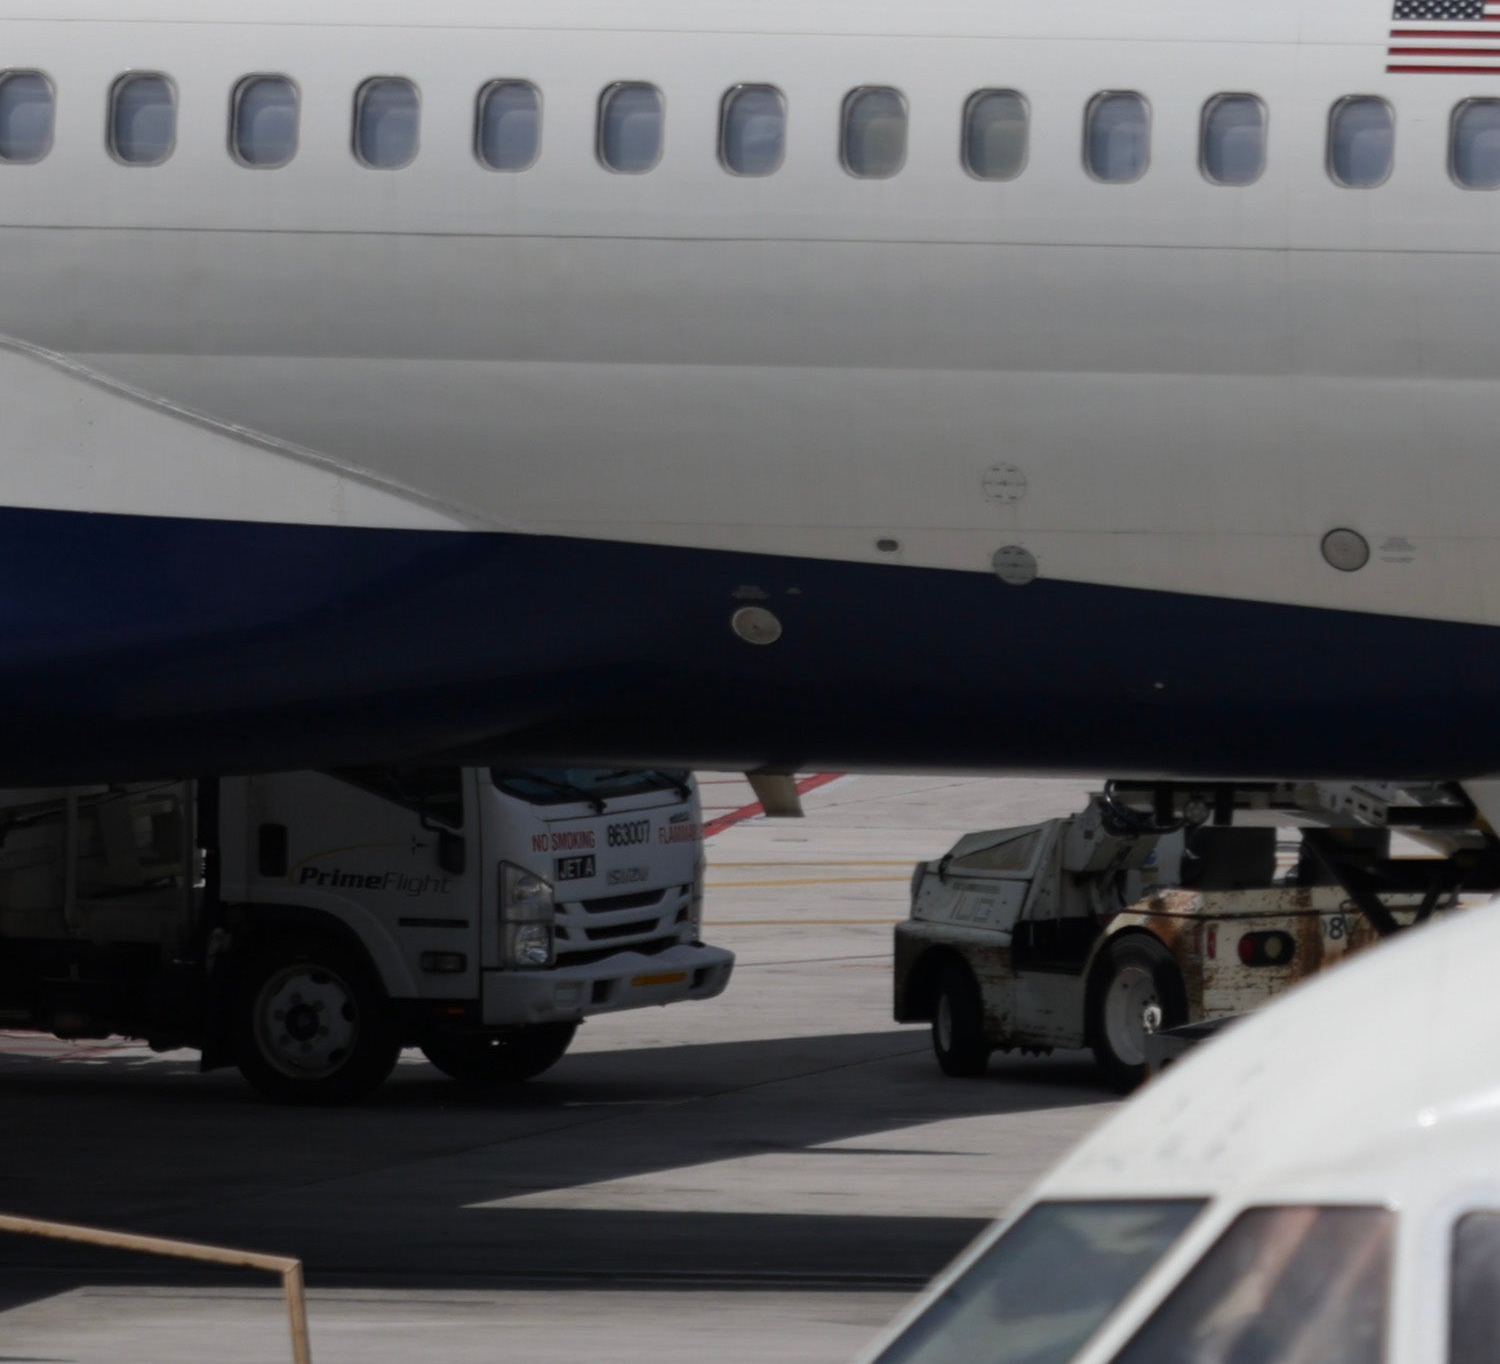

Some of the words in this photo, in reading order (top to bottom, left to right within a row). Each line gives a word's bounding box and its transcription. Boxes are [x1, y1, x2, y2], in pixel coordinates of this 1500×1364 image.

[532, 833, 549, 852] NO
[551, 830, 596, 851] SMOKING
[607, 820, 651, 848] 863007
[560, 857, 582, 879] JET
[584, 856, 595, 877] A
[301, 865, 451, 897] PrimeFlight
